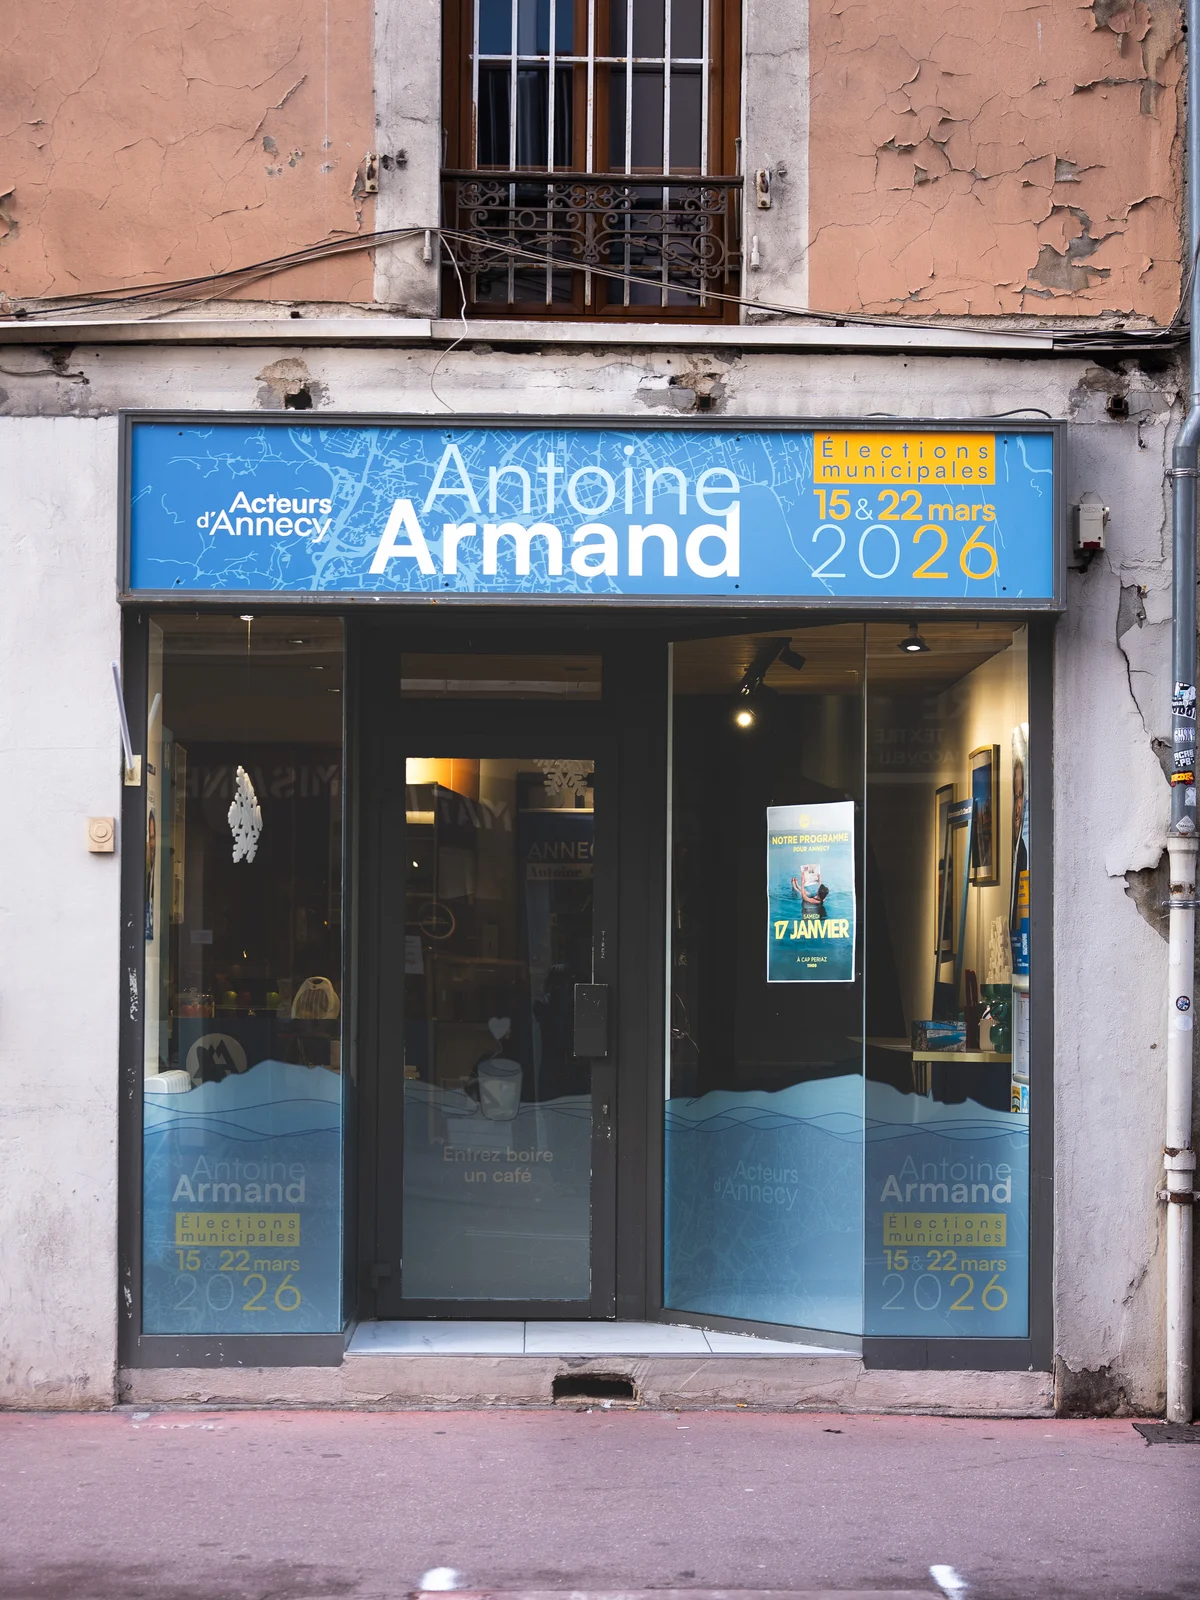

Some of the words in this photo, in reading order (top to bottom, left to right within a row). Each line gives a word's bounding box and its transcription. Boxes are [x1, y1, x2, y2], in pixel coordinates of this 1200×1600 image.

[822, 436, 988, 459] Élections
[422, 444, 741, 516] Antoine
[822, 461, 988, 483] municipales
[228, 491, 332, 514] Acteurs
[813, 489, 851, 520] 15
[855, 498, 873, 520] &
[878, 489, 923, 520] 22
[928, 503, 996, 521] mars
[197, 509, 333, 543] d'Annecy
[368, 498, 741, 578] Armand
[811, 523, 998, 580] 2026
[772, 836, 798, 845] NOTRE
[799, 833, 849, 844] PROGRAMME
[774, 920, 789, 939] 17
[790, 919, 849, 939] JANVIER
[443, 1146, 501, 1162] Entrez
[506, 1146, 554, 1162] boire
[191, 1154, 306, 1181] Antoine
[464, 1170, 487, 1183] un
[492, 1167, 532, 1183] café
[733, 1159, 799, 1184] Acteurs
[900, 1155, 1012, 1181] Antoine
[172, 1174, 306, 1203] Armand
[714, 1177, 799, 1211] d'Annecy
[879, 1174, 1012, 1203] Armand
[181, 1213, 296, 1229] Élections
[889, 1213, 1002, 1229] Élections
[181, 1230, 296, 1245] municipales
[889, 1230, 1002, 1245] municipales
[175, 1250, 201, 1271] 15
[203, 1255, 217, 1271] &
[219, 1250, 250, 1271] 22
[253, 1257, 300, 1271] mars
[883, 1250, 909, 1271] 15
[911, 1255, 923, 1271] &
[927, 1250, 957, 1271] 22
[960, 1258, 1007, 1271] mars
[173, 1273, 302, 1312] 2026
[881, 1273, 1008, 1311] 2026
